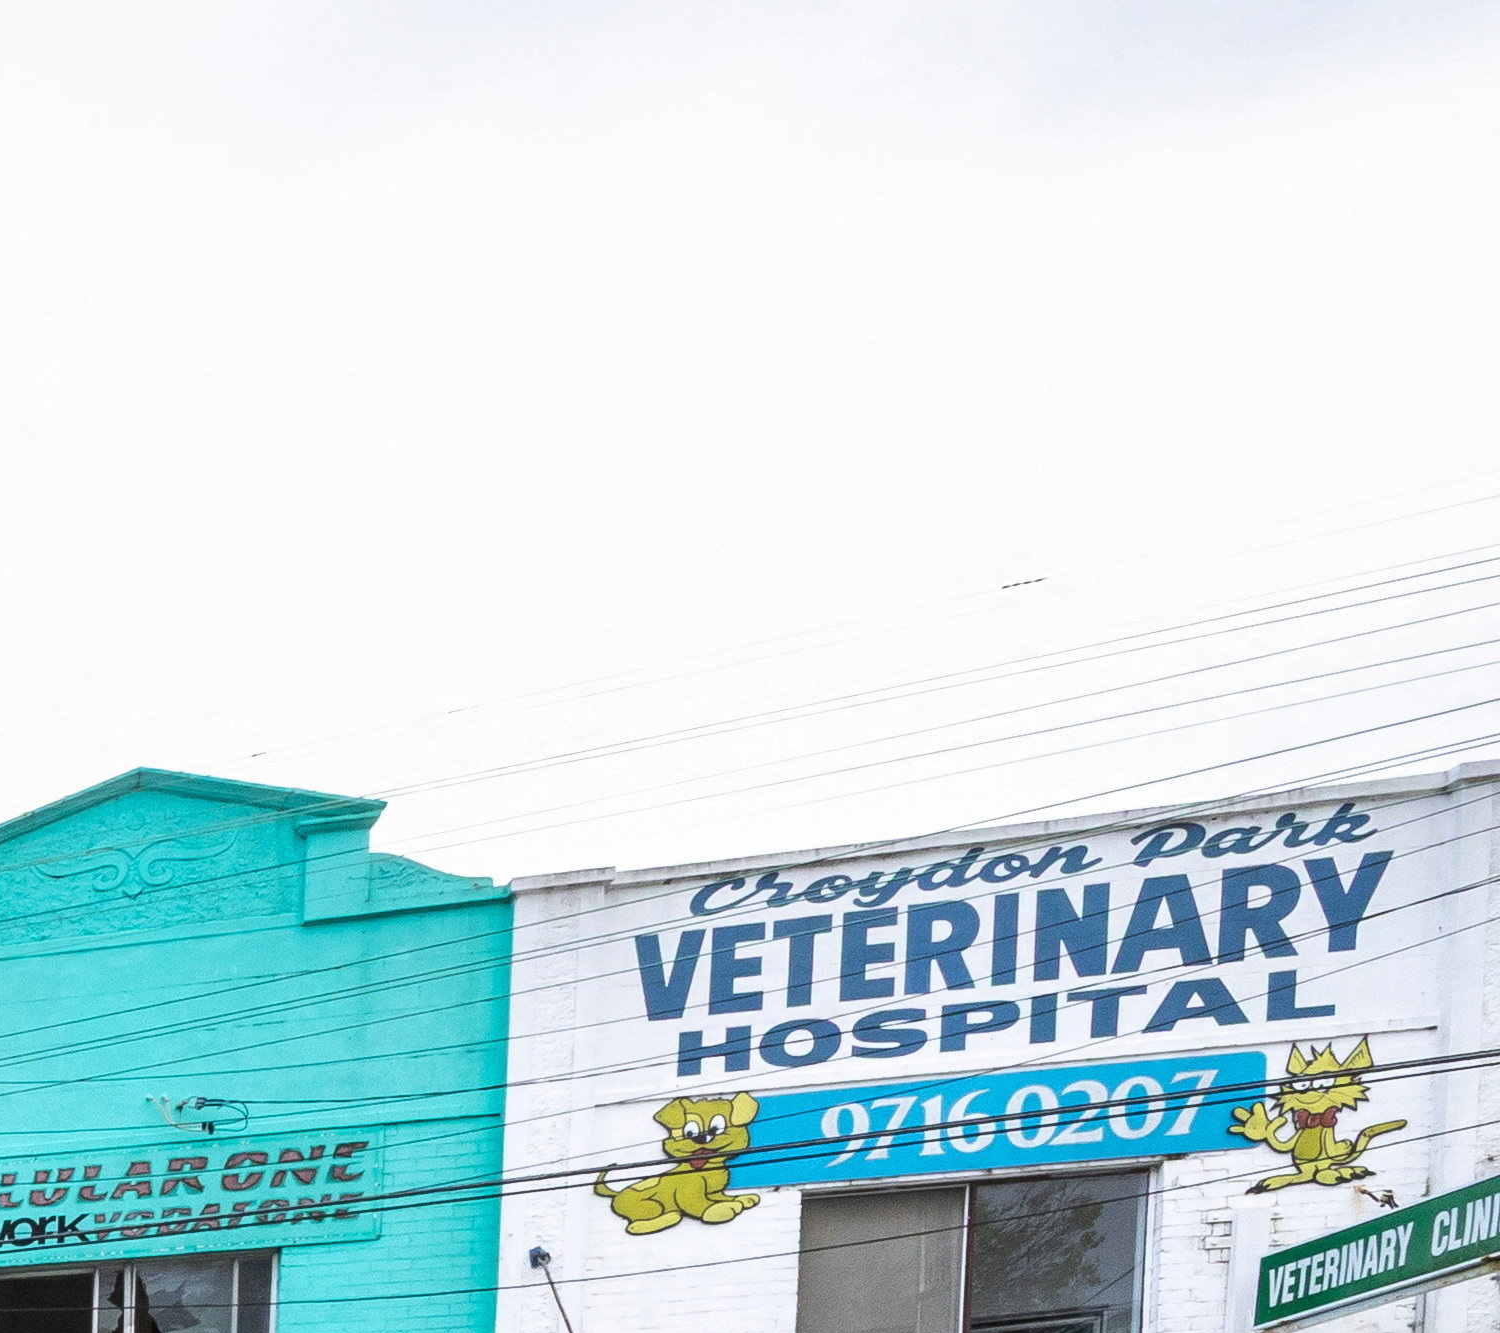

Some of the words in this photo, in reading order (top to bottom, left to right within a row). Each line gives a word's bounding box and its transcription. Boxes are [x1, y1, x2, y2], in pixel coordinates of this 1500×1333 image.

[690, 844, 1103, 918] Croydon
[1131, 803, 1378, 867] Park
[634, 850, 1394, 1022] VETERINARY
[676, 970, 1335, 1077] HOSPITAL
[220, 1141, 368, 1192] ONE
[1268, 1221, 1414, 1308] VETERINARY
